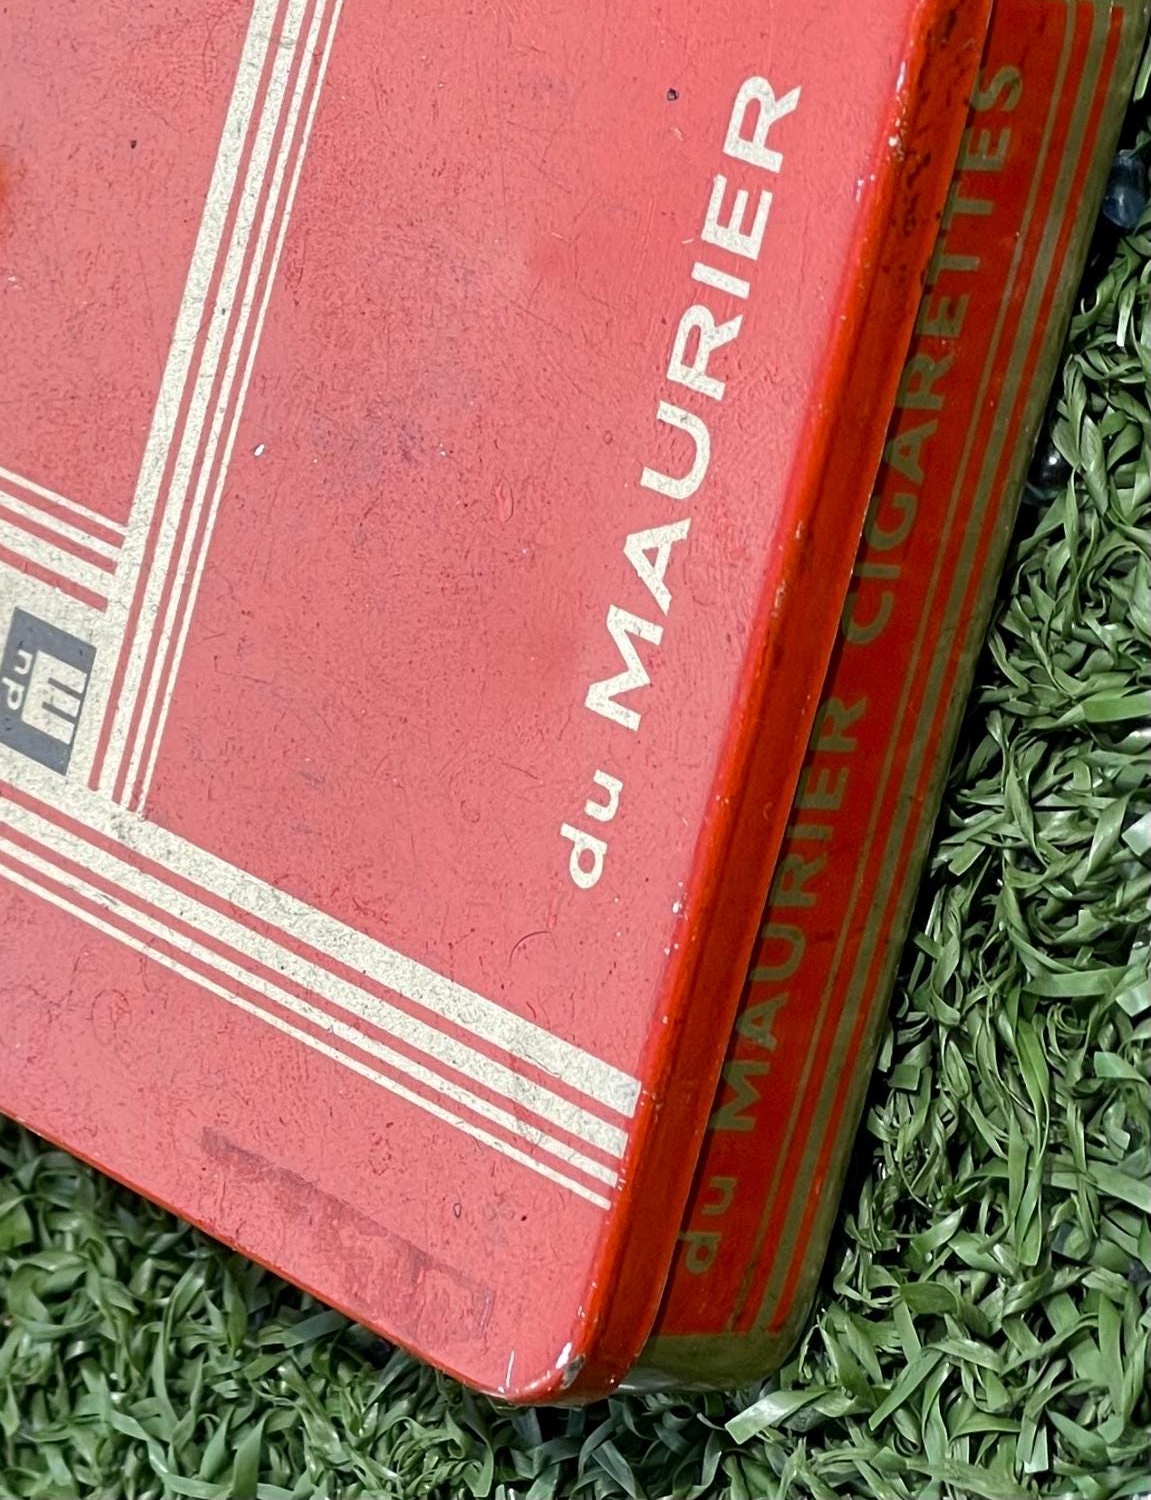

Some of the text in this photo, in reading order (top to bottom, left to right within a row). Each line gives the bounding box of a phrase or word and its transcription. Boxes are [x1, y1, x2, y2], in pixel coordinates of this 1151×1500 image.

[1, 649, 33, 711] du
[560, 75, 802, 890] du MAURIER
[676, 64, 1023, 1274] du MAURIER CIGARETTES
